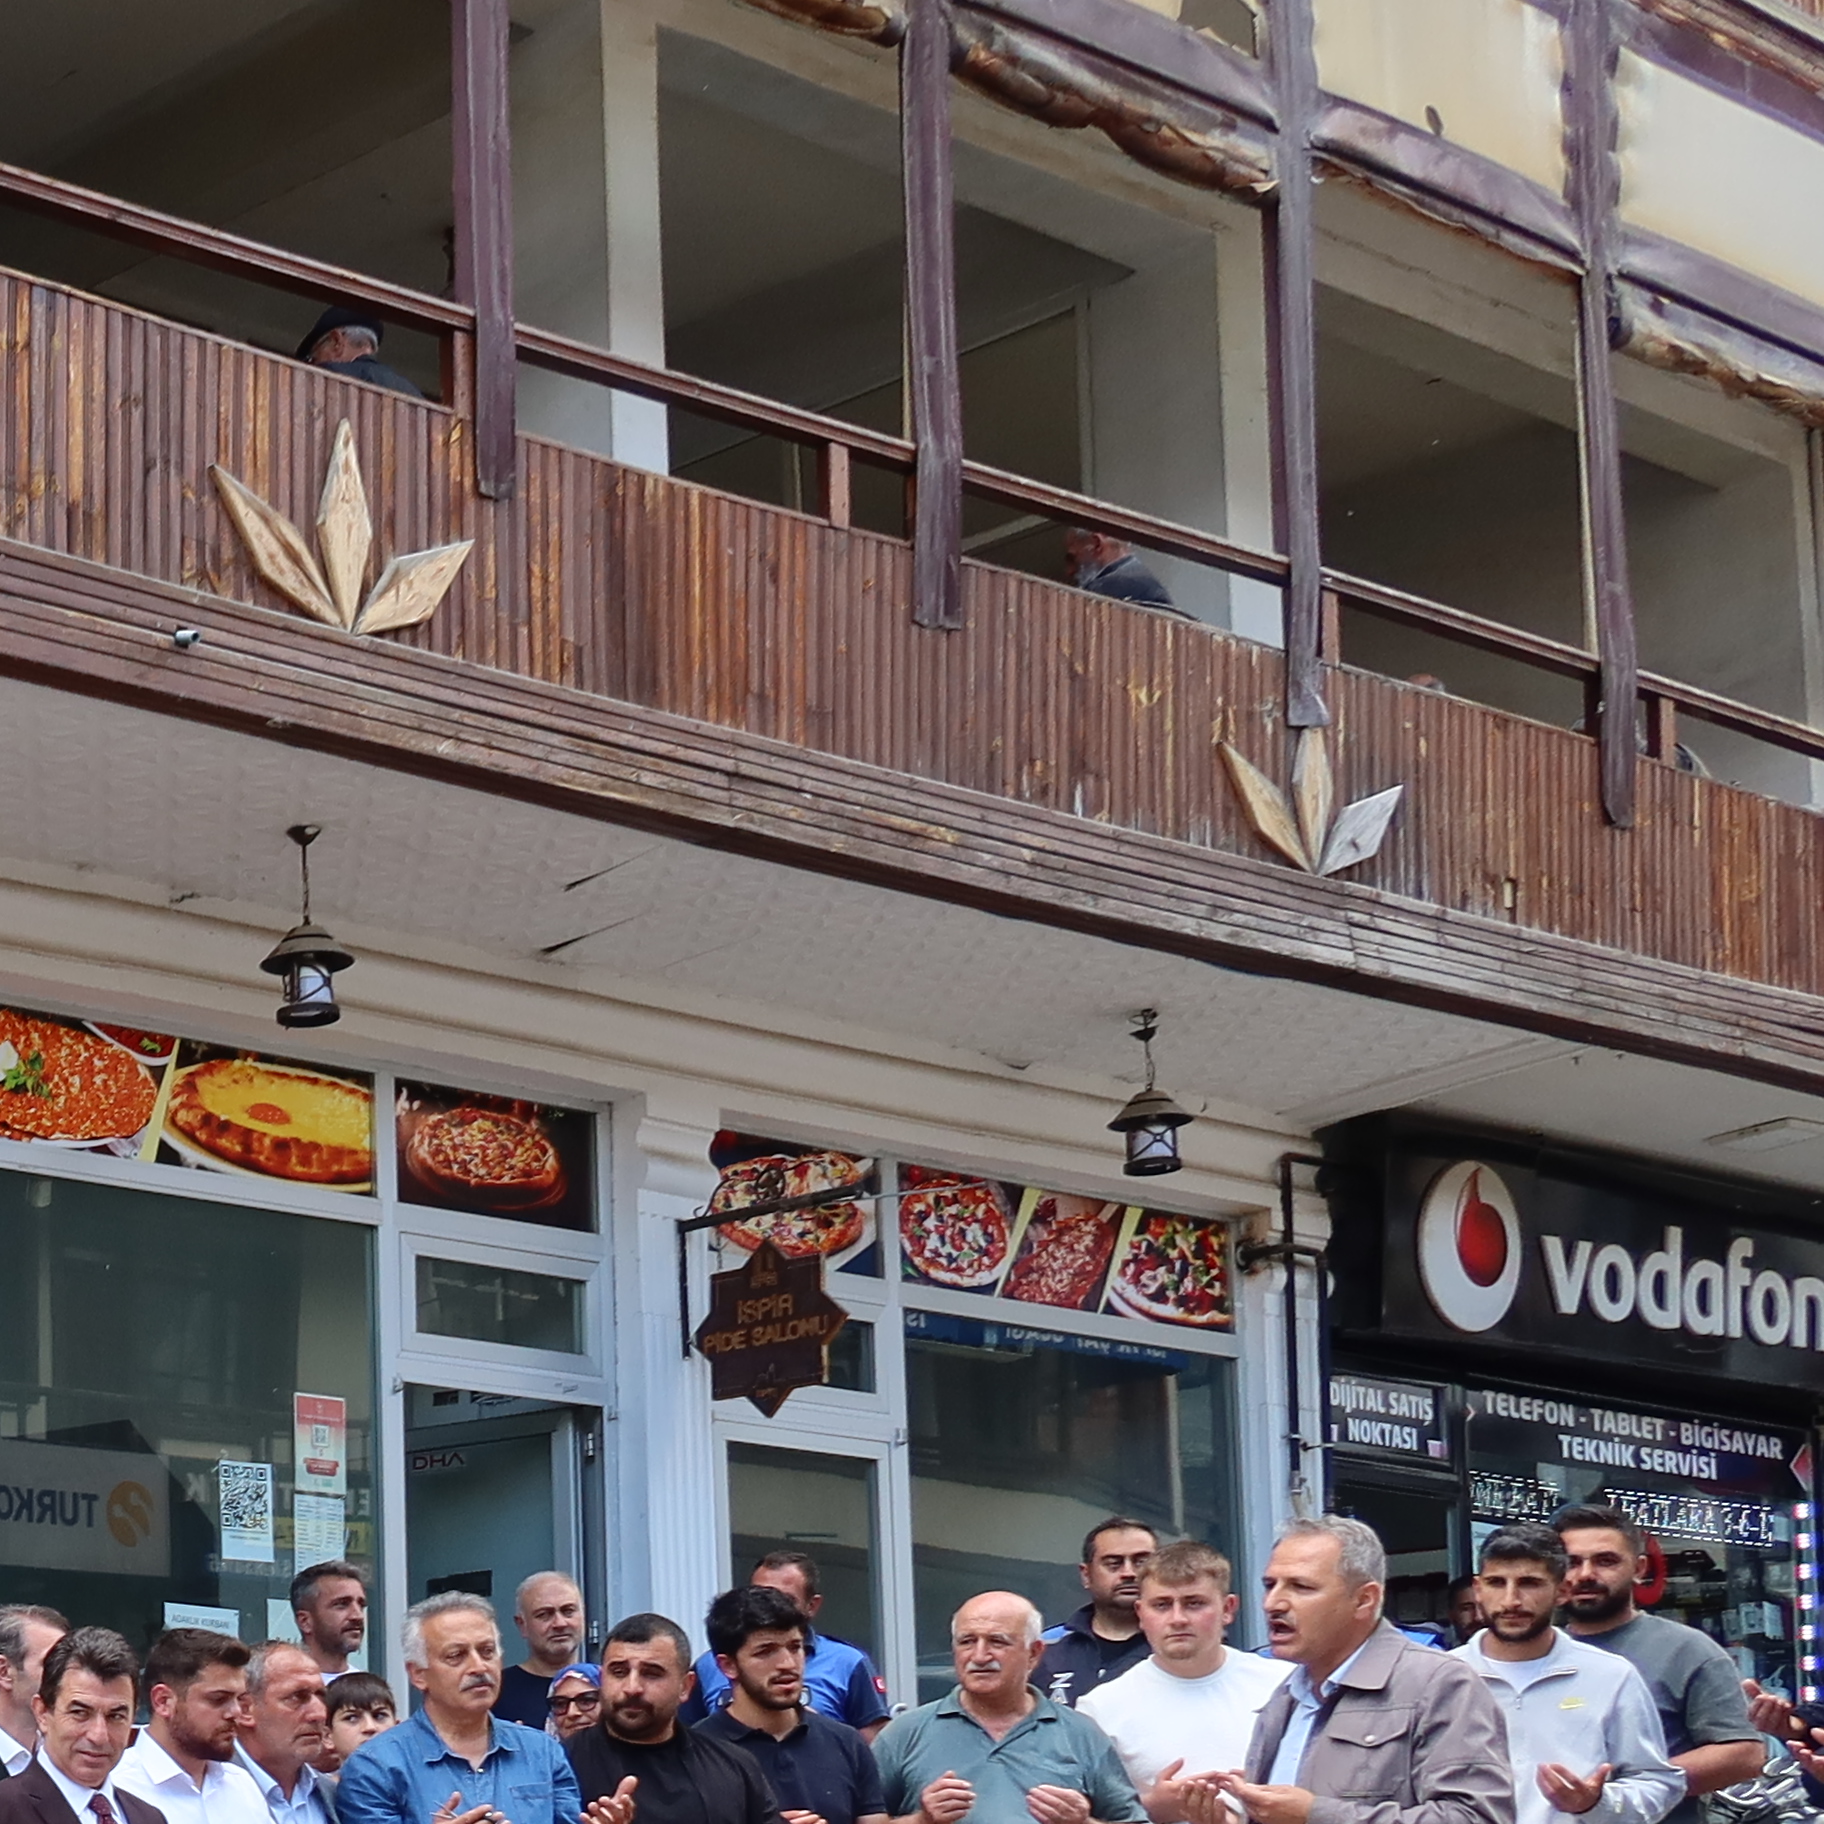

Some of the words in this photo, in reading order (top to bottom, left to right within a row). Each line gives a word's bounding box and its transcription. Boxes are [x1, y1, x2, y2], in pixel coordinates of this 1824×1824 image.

[1388, 1391, 1434, 1427] SATIŞ
[1482, 1390, 1575, 1428] TELEFON
[1590, 1407, 1665, 1441] TABLET
[1347, 1417, 1418, 1452] NOKTASI
[1558, 1434, 1637, 1468] TEKNİK
[1640, 1446, 1719, 1480] SERVİSİ
